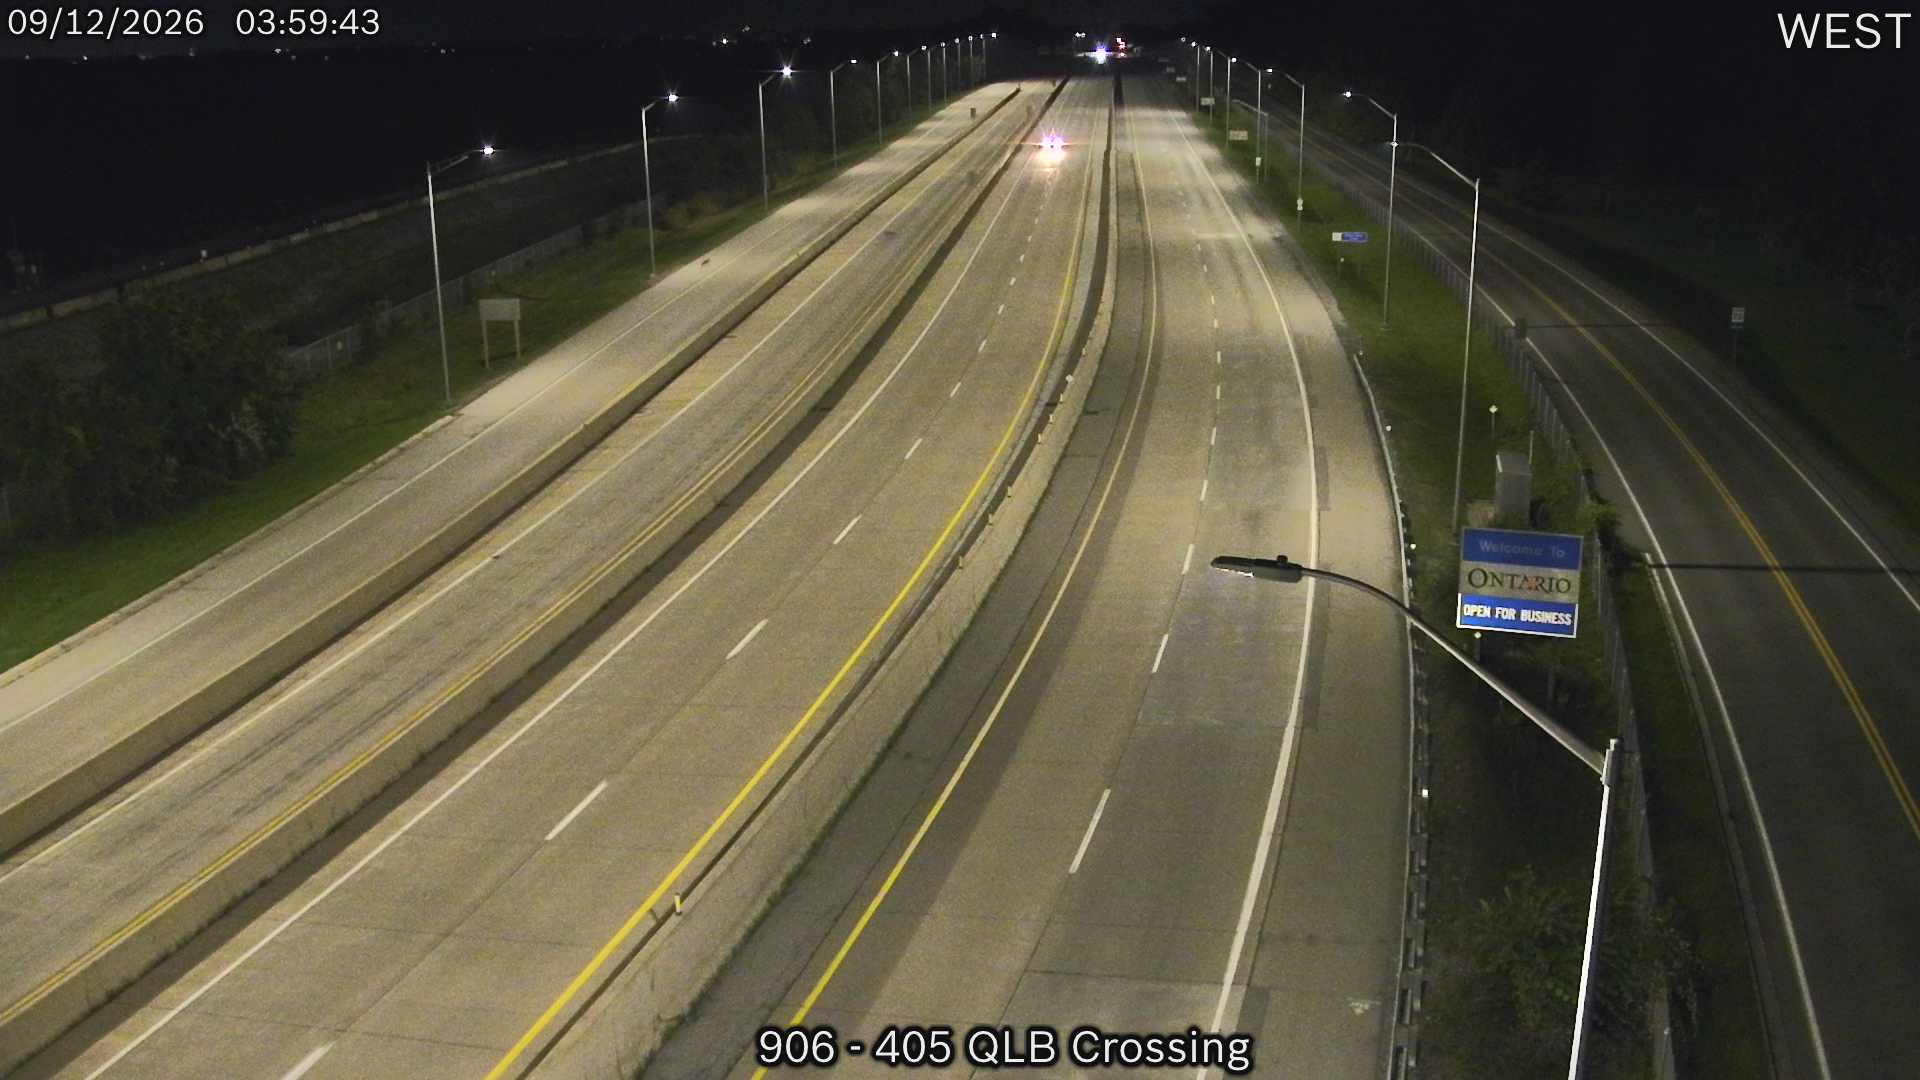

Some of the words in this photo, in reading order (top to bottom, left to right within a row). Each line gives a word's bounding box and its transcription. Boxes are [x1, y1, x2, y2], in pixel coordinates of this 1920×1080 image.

[1479, 540, 1544, 556] Welcome
[1468, 568, 1571, 593] ONTARIO
[1463, 604, 1491, 618] OPEN
[1495, 607, 1516, 620] FOR
[1520, 609, 1572, 626] BUSINESS
